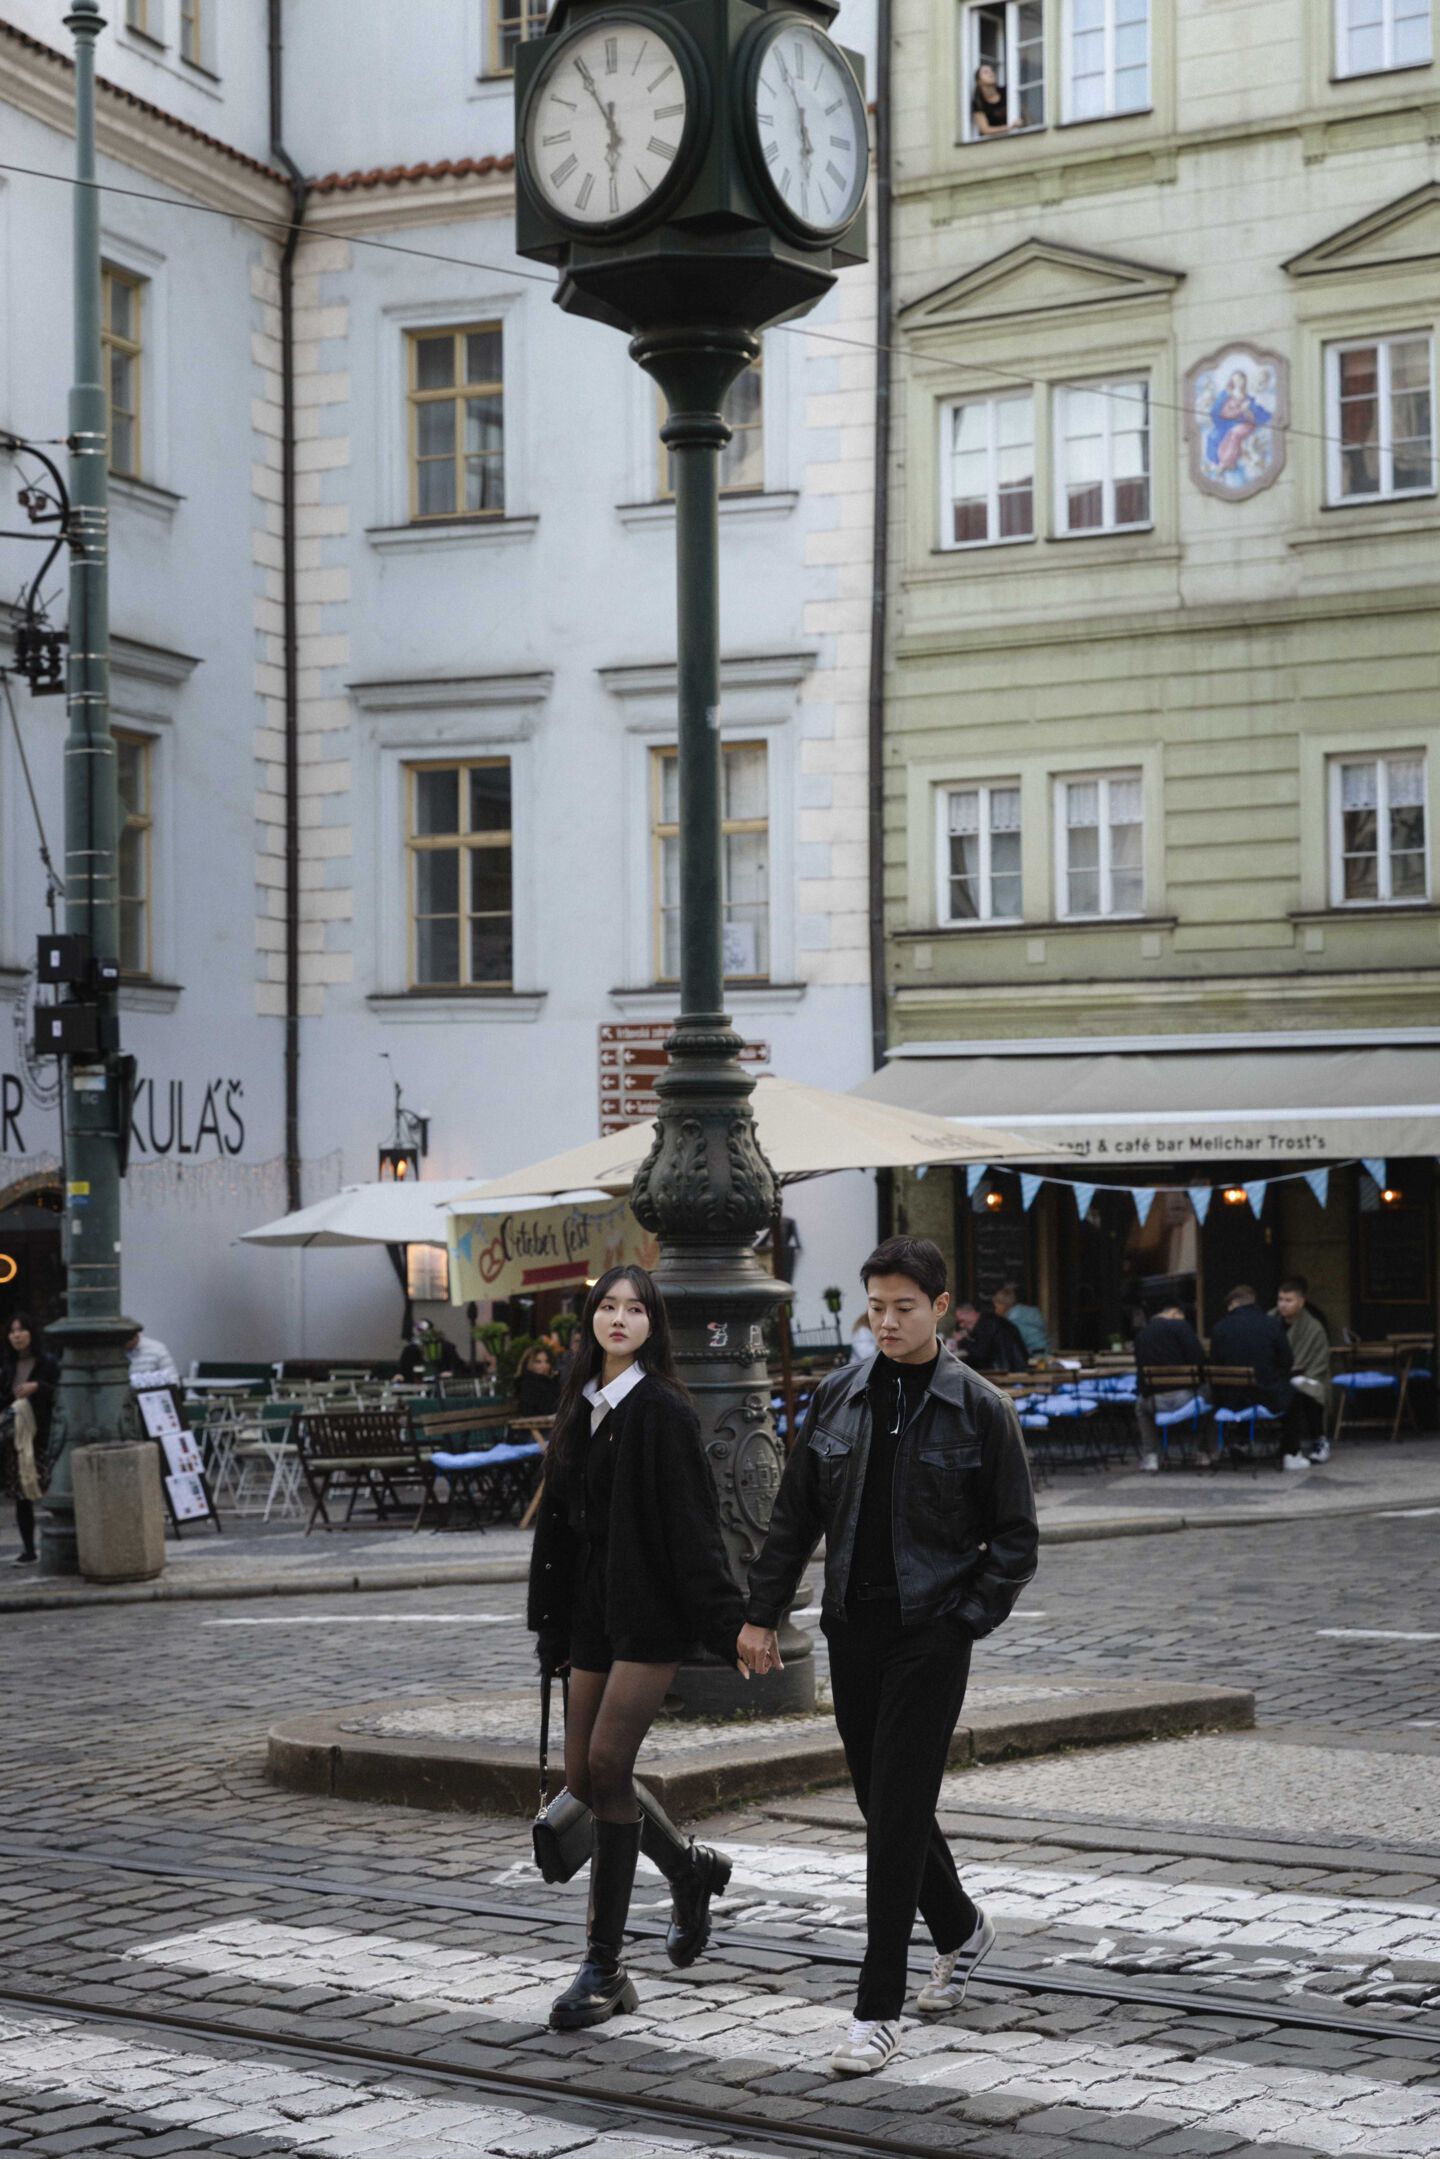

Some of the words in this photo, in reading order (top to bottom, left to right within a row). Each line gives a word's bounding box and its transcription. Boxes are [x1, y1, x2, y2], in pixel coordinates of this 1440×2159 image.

[1115, 1137, 1151, 1153] café
[1156, 1138, 1183, 1152] bar
[1190, 1135, 1262, 1151] Melichar
[1268, 1134, 1326, 1150] Trost's
